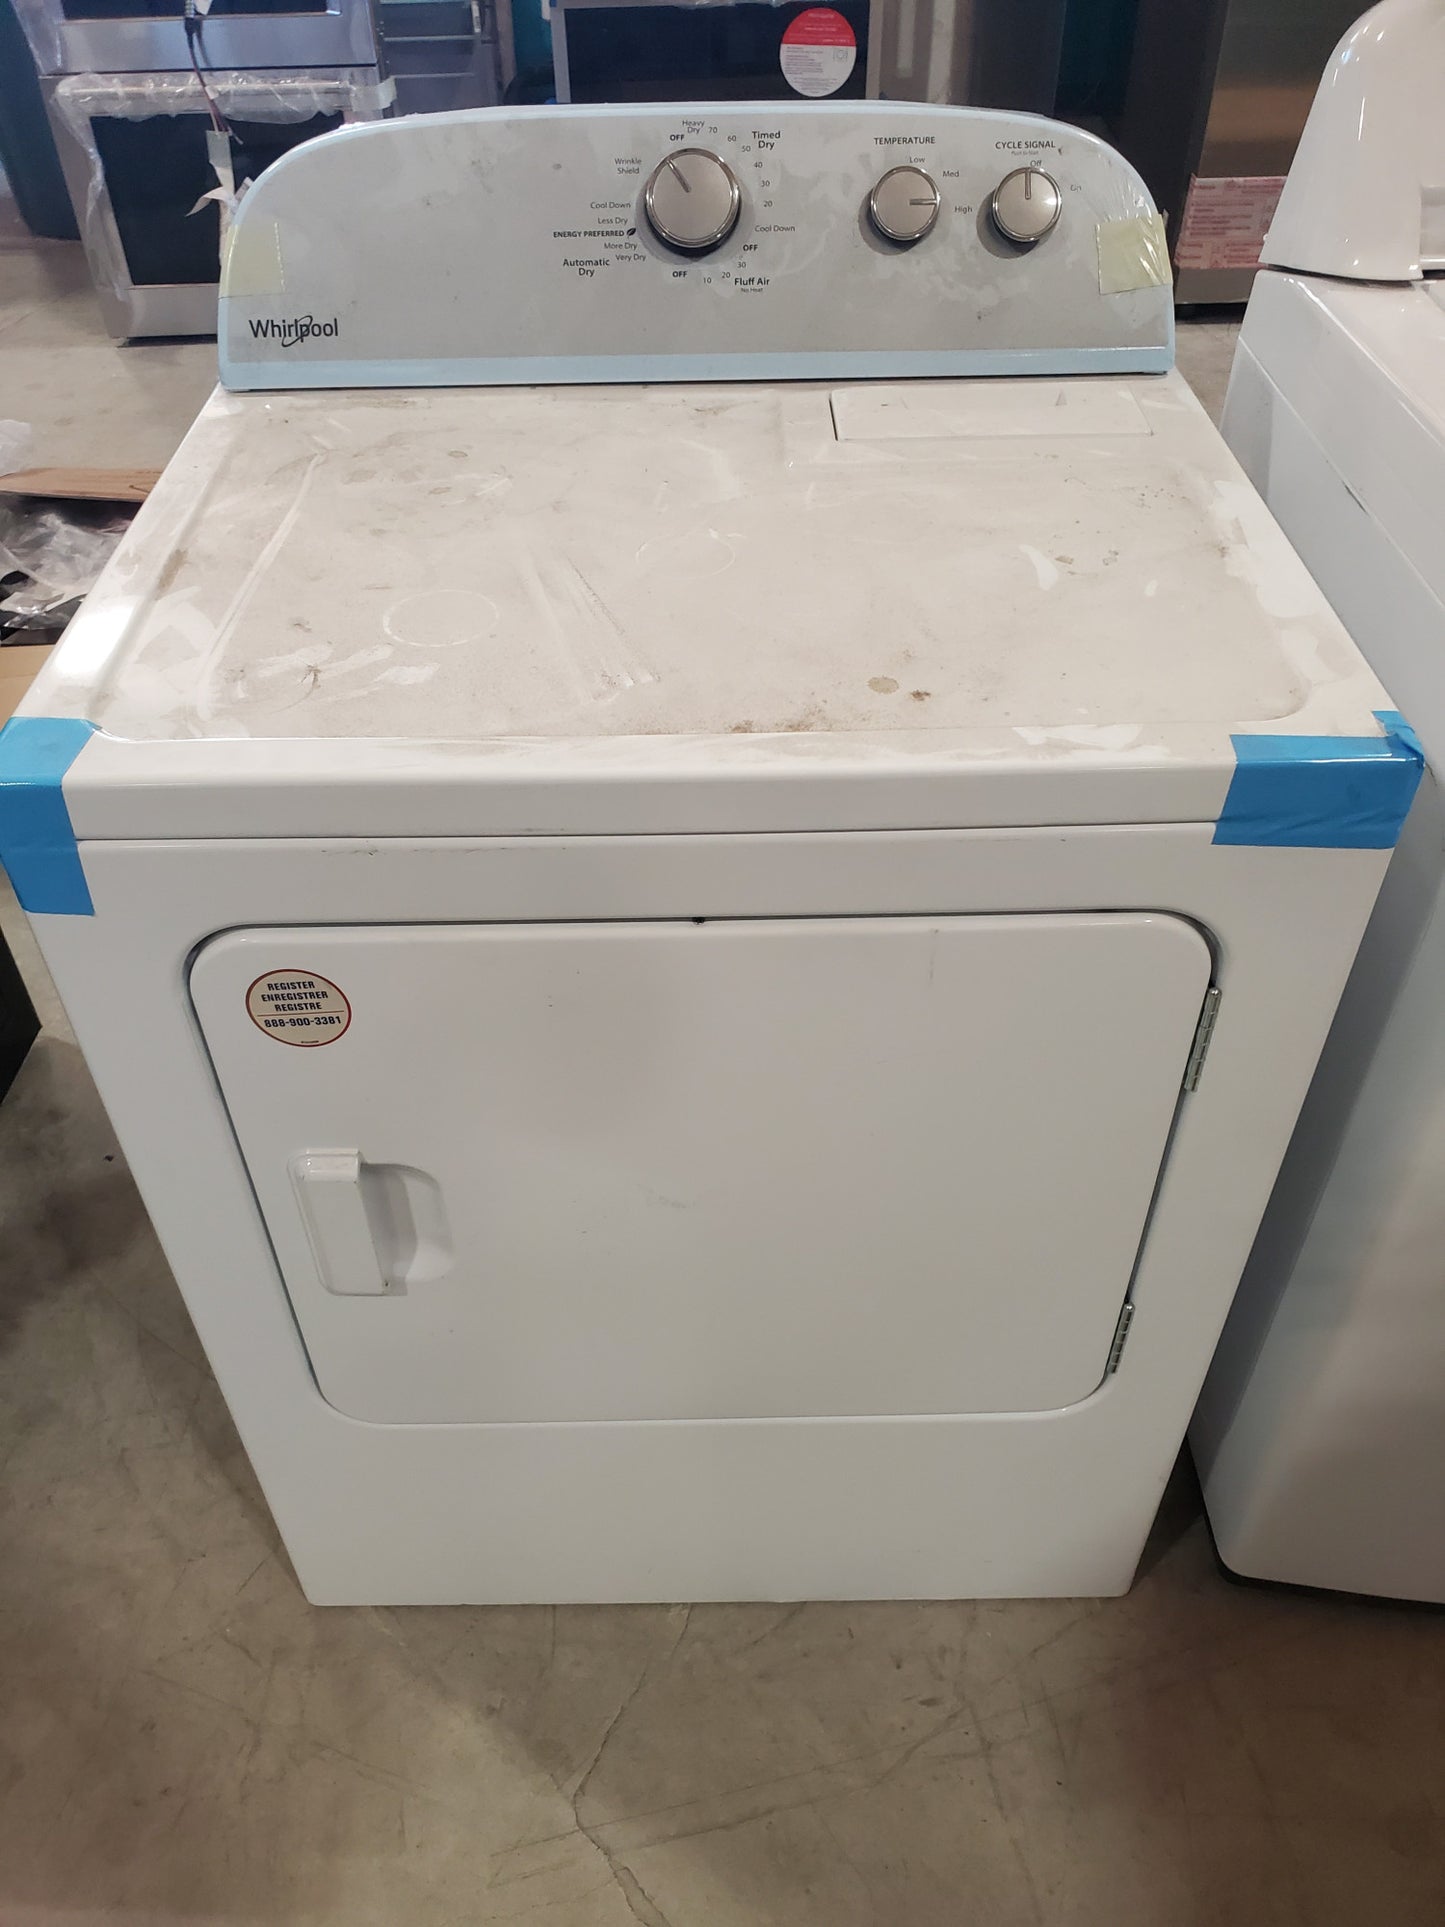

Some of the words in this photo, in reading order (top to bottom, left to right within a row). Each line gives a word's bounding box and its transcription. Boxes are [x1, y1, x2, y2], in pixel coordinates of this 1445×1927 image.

[682, 120, 704, 128] Heavy
[752, 131, 780, 139] Timed
[758, 141, 774, 150] Dry
[874, 137, 935, 145] TEMPERATURE
[955, 206, 973, 214] High
[615, 217, 628, 226] Dry
[624, 242, 637, 251] Dry
[563, 258, 610, 267] Automatic
[616, 254, 631, 262] Very
[633, 254, 646, 262] Dry
[579, 268, 595, 277] Dry
[734, 278, 755, 286] Fluff
[756, 277, 770, 286] Air
[249, 315, 338, 347] Whirlpool
[268, 981, 315, 991] REGISTER
[261, 991, 328, 1002] ENREGISTRER
[275, 1002, 322, 1012] REGISTRE
[264, 1016, 341, 1027] 888-900-3381
